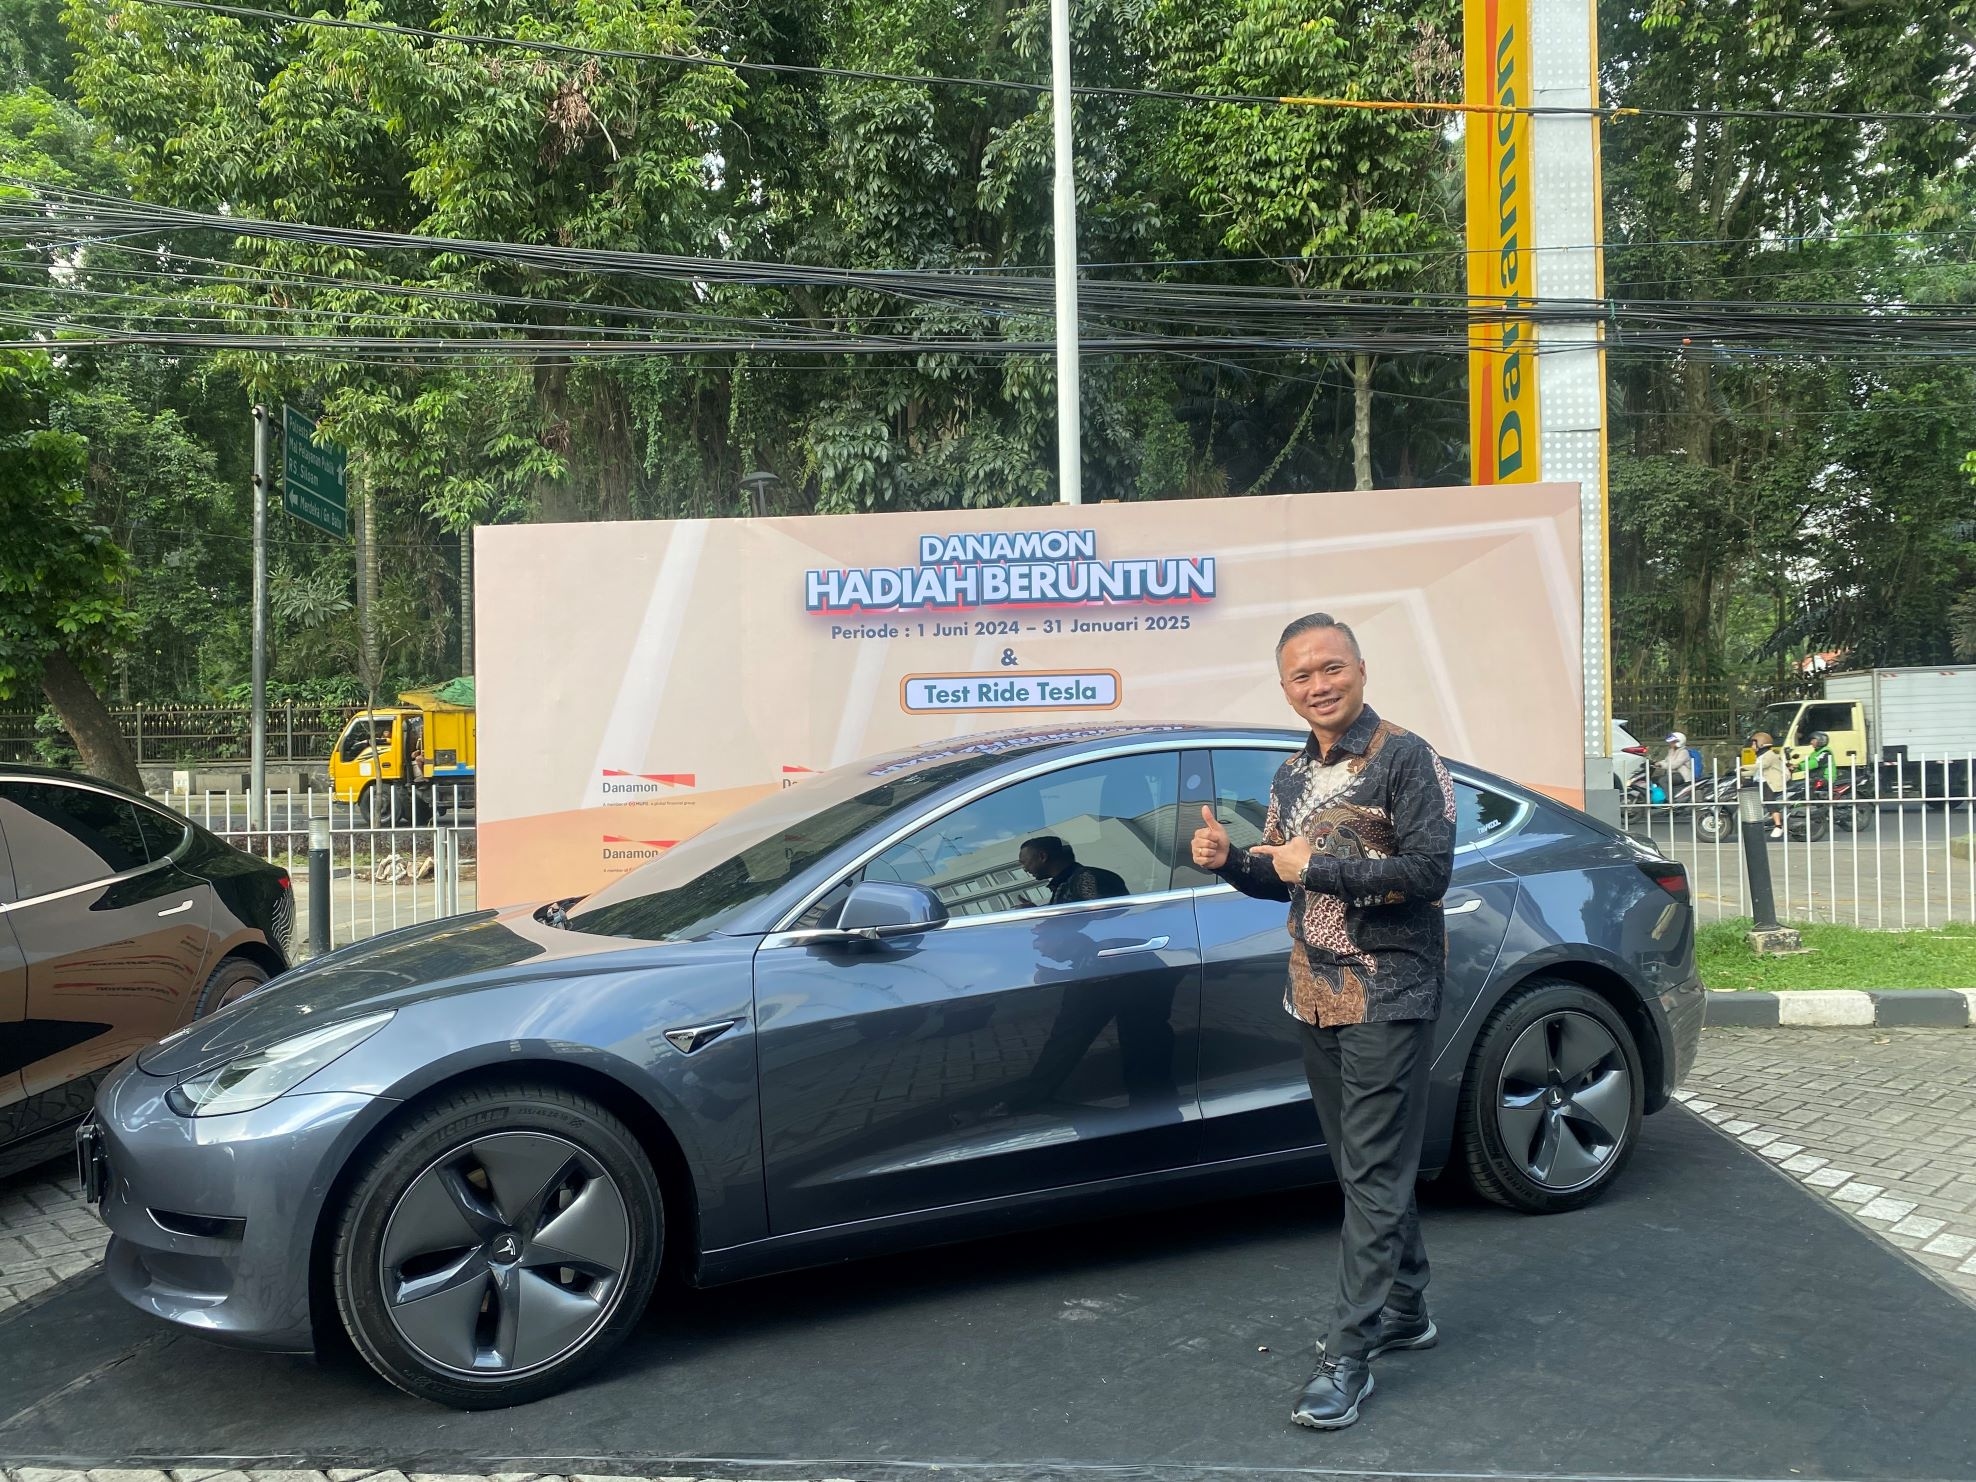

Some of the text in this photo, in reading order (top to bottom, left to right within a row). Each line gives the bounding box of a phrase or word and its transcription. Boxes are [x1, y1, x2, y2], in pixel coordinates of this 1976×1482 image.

[1497, 23, 1523, 481] Danamon
[300, 463, 319, 486] Siloam
[920, 530, 1096, 565] DANAMON
[805, 556, 1217, 610] HADIAH BERUNTUN
[831, 623, 899, 639] Periode
[917, 623, 924, 637] 1
[933, 622, 968, 637] Juni
[974, 621, 1020, 636] 2024
[1043, 619, 1062, 633] 31
[1070, 616, 1139, 633] Januari
[1144, 615, 1190, 630] 2025
[1000, 647, 1019, 666] &
[924, 679, 1097, 704] Test Ride Tesla
[602, 782, 658, 793] Danamon
